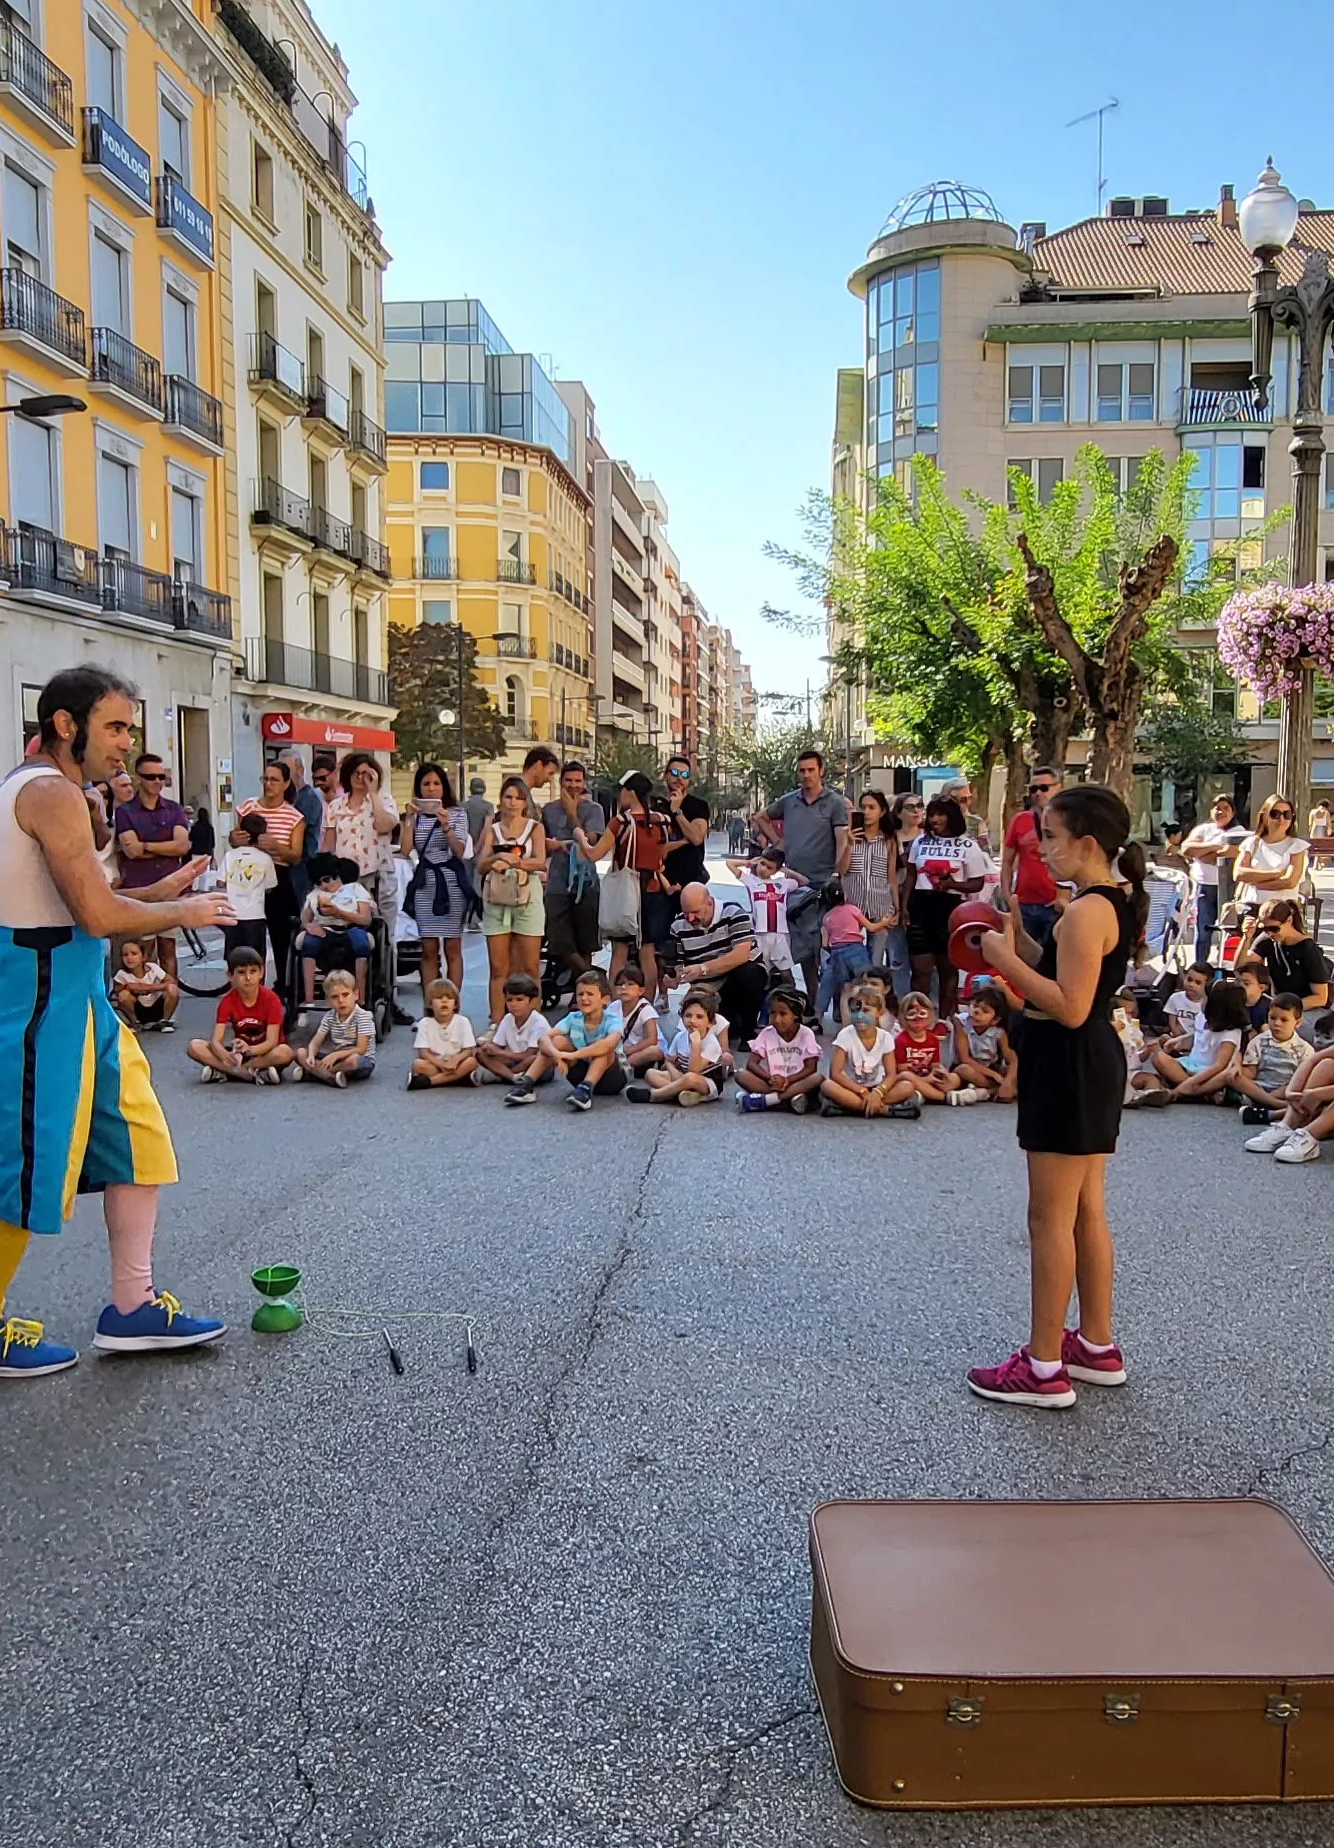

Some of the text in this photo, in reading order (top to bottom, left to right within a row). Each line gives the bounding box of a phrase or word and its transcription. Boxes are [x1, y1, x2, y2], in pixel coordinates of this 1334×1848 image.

[102, 128, 149, 185] PODÓLOGO
[883, 754, 941, 769] MANGO
[920, 846, 961, 858] BULLS
